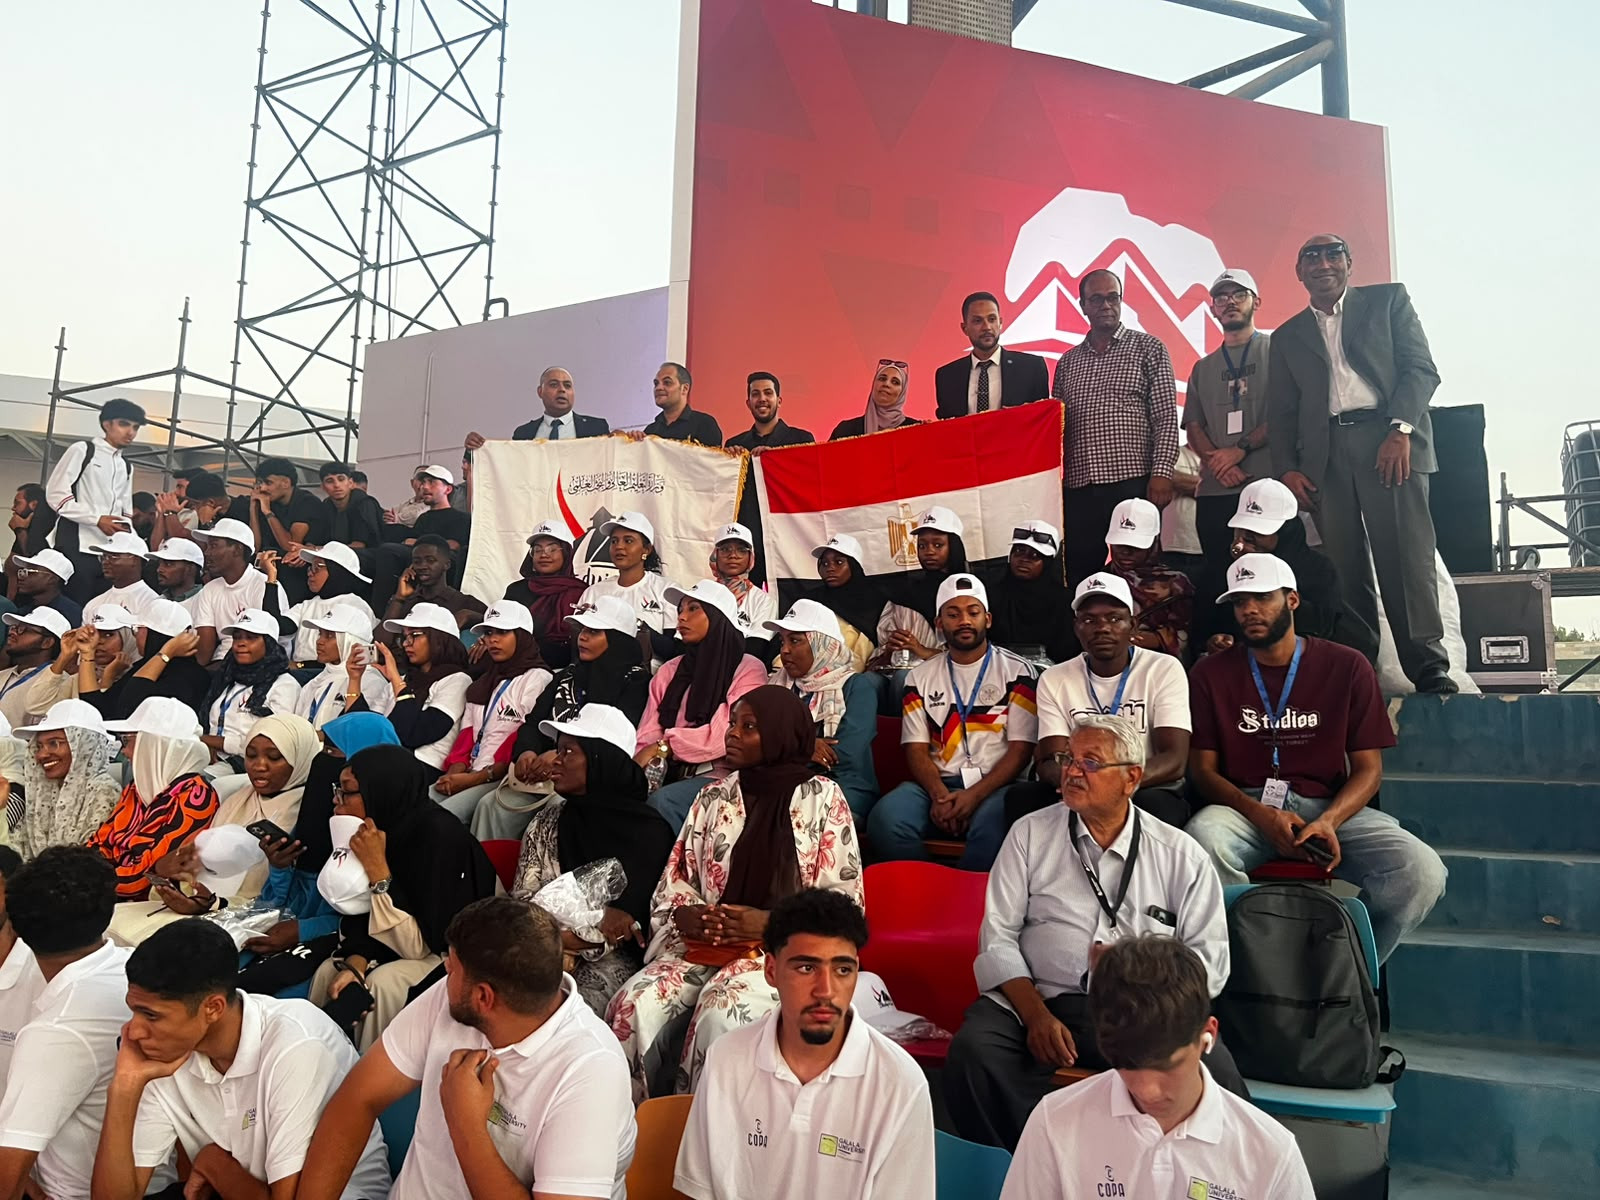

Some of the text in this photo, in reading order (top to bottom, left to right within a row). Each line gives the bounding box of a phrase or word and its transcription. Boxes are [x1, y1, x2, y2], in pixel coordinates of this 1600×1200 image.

[748, 1133, 768, 1148] COPA
[1097, 1182, 1125, 1198] COPA
[1209, 1183, 1235, 1195] GALALA
